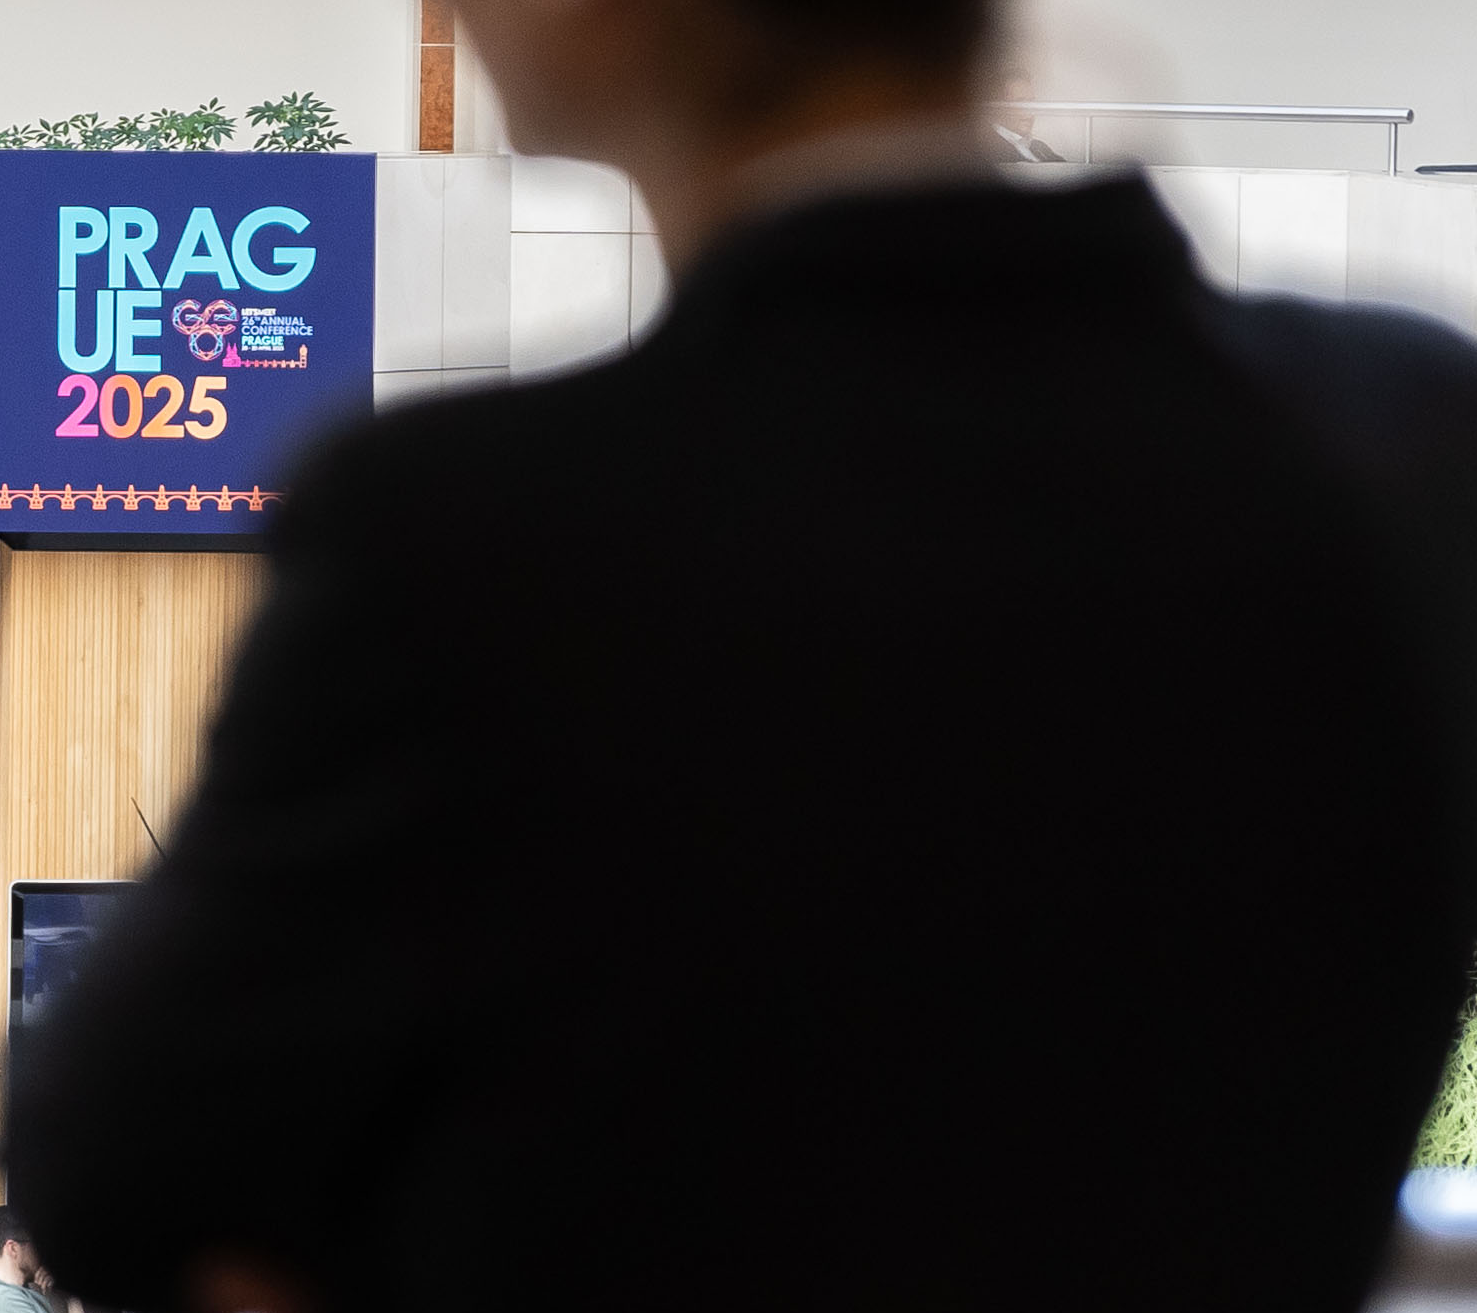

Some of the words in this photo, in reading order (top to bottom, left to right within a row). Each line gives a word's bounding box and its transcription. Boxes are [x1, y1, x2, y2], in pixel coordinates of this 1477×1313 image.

[58, 206, 316, 292] PRAG
[57, 289, 162, 372] UE
[241, 325, 313, 335] CONFERENCE
[260, 316, 305, 325] ANNUAL
[241, 336, 284, 345] PRAGUE
[55, 373, 228, 439] 2025
